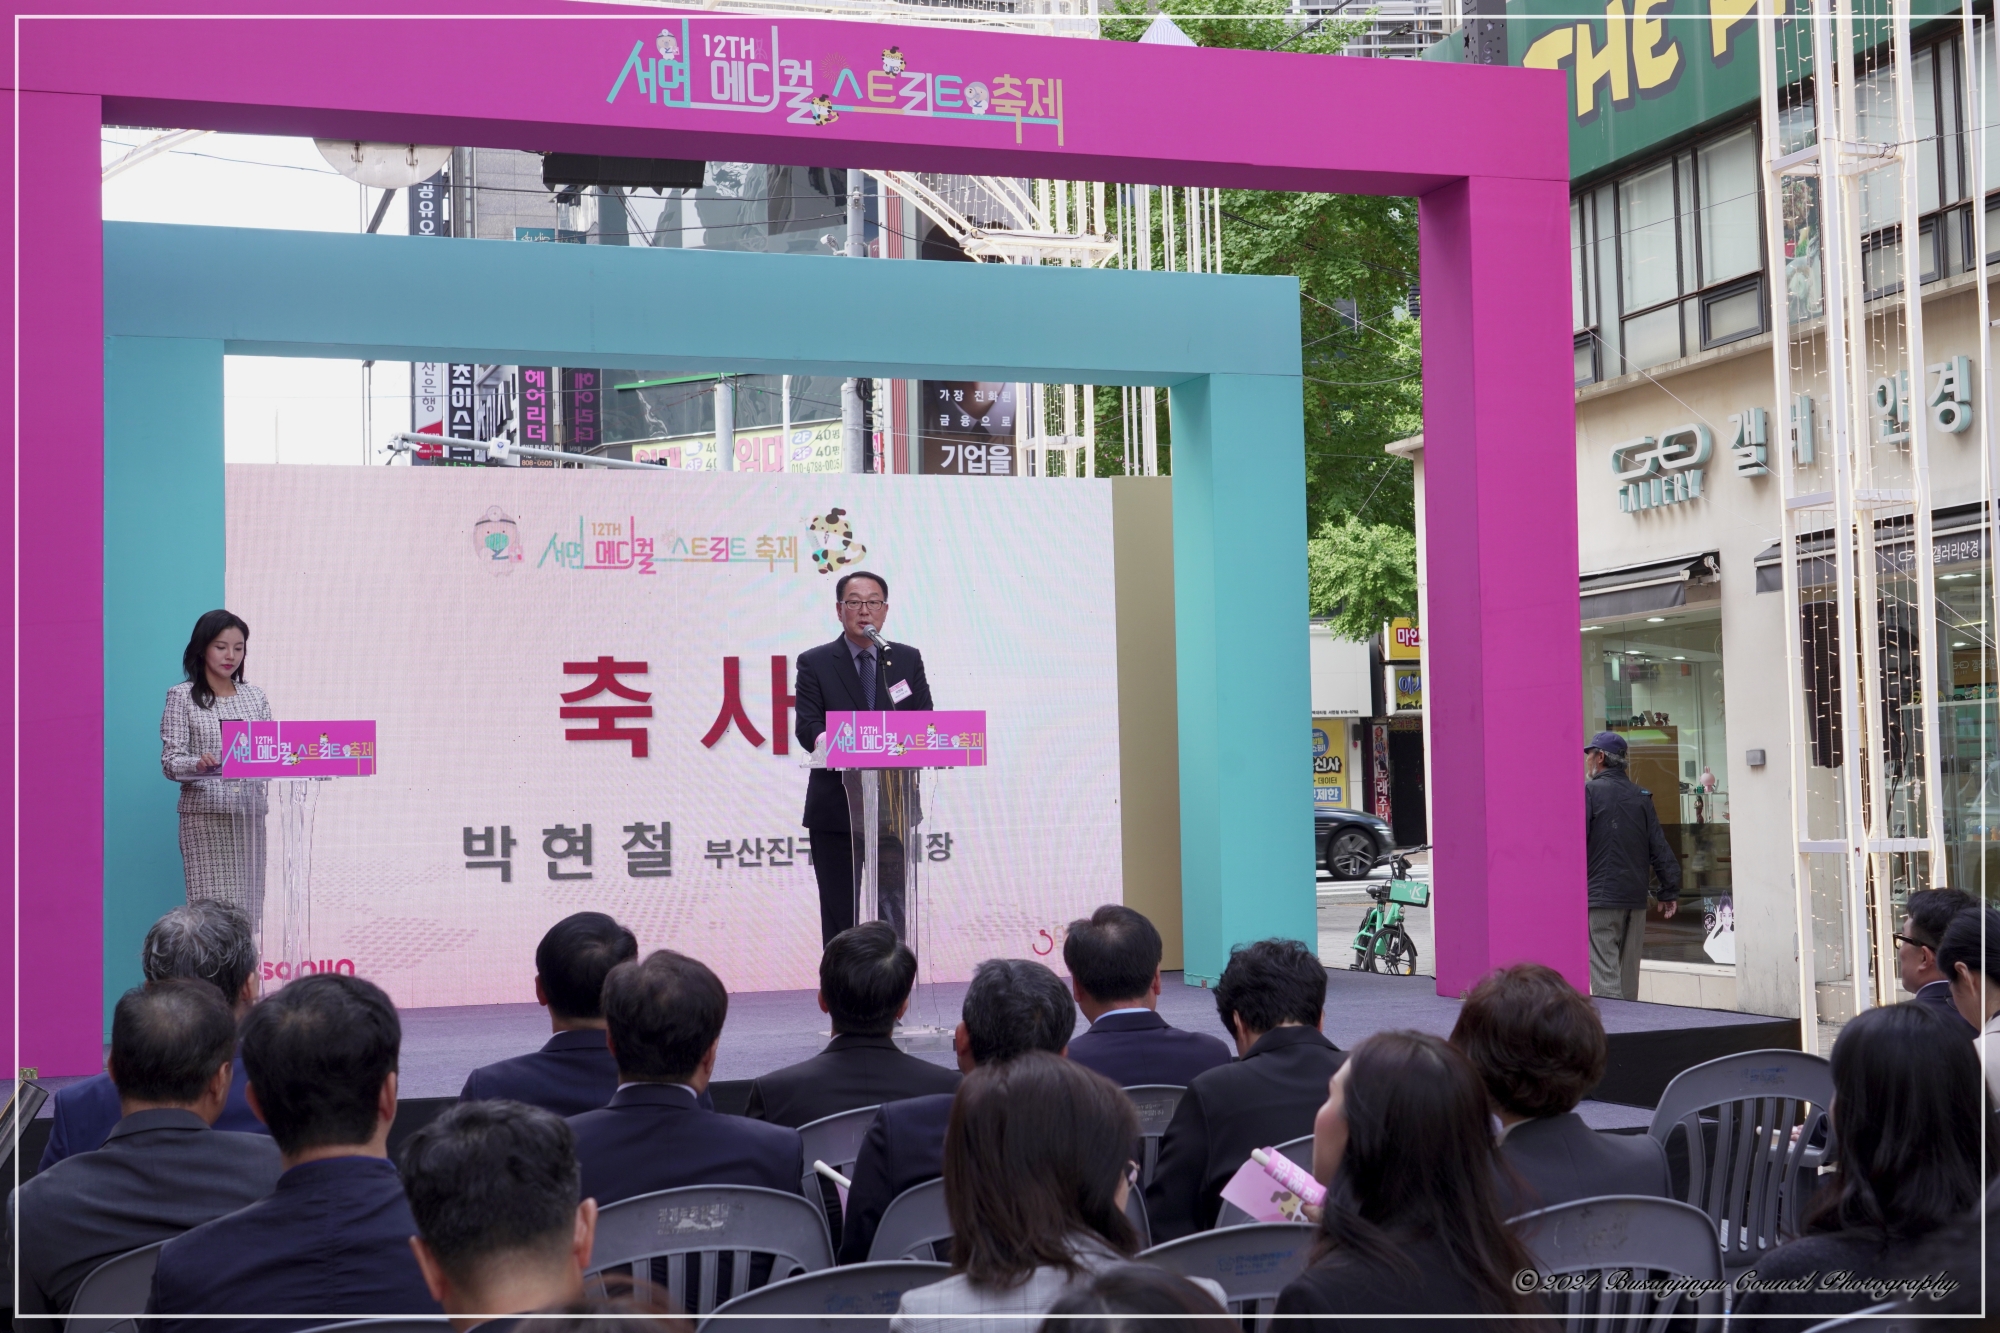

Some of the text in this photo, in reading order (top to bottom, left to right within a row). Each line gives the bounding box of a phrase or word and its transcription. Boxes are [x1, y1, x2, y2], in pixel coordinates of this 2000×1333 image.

[702, 34, 756, 59] 12TH
[1523, 0, 1679, 117] THE
[606, 19, 691, 108] 서면
[711, 25, 816, 125] 메디컬
[991, 74, 1064, 146] 축제
[524, 369, 547, 442] 헤어리더
[940, 389, 1012, 403] 가장 진화된
[794, 431, 810, 444] 2F
[940, 444, 1012, 474] 기업을
[1617, 469, 1703, 514] GALLERY
[591, 522, 622, 536] 12TH
[537, 515, 584, 569] 서면
[595, 515, 657, 574] 메디컬
[755, 536, 799, 573] 축제
[254, 735, 273, 745] 12TH
[859, 726, 878, 735] 12TH
[862, 711, 898, 756] 메디컬
[959, 731, 984, 766] 축제
[257, 721, 292, 766] 메디컬
[349, 741, 374, 776] 축제
[1314, 757, 1340, 772] 신사
